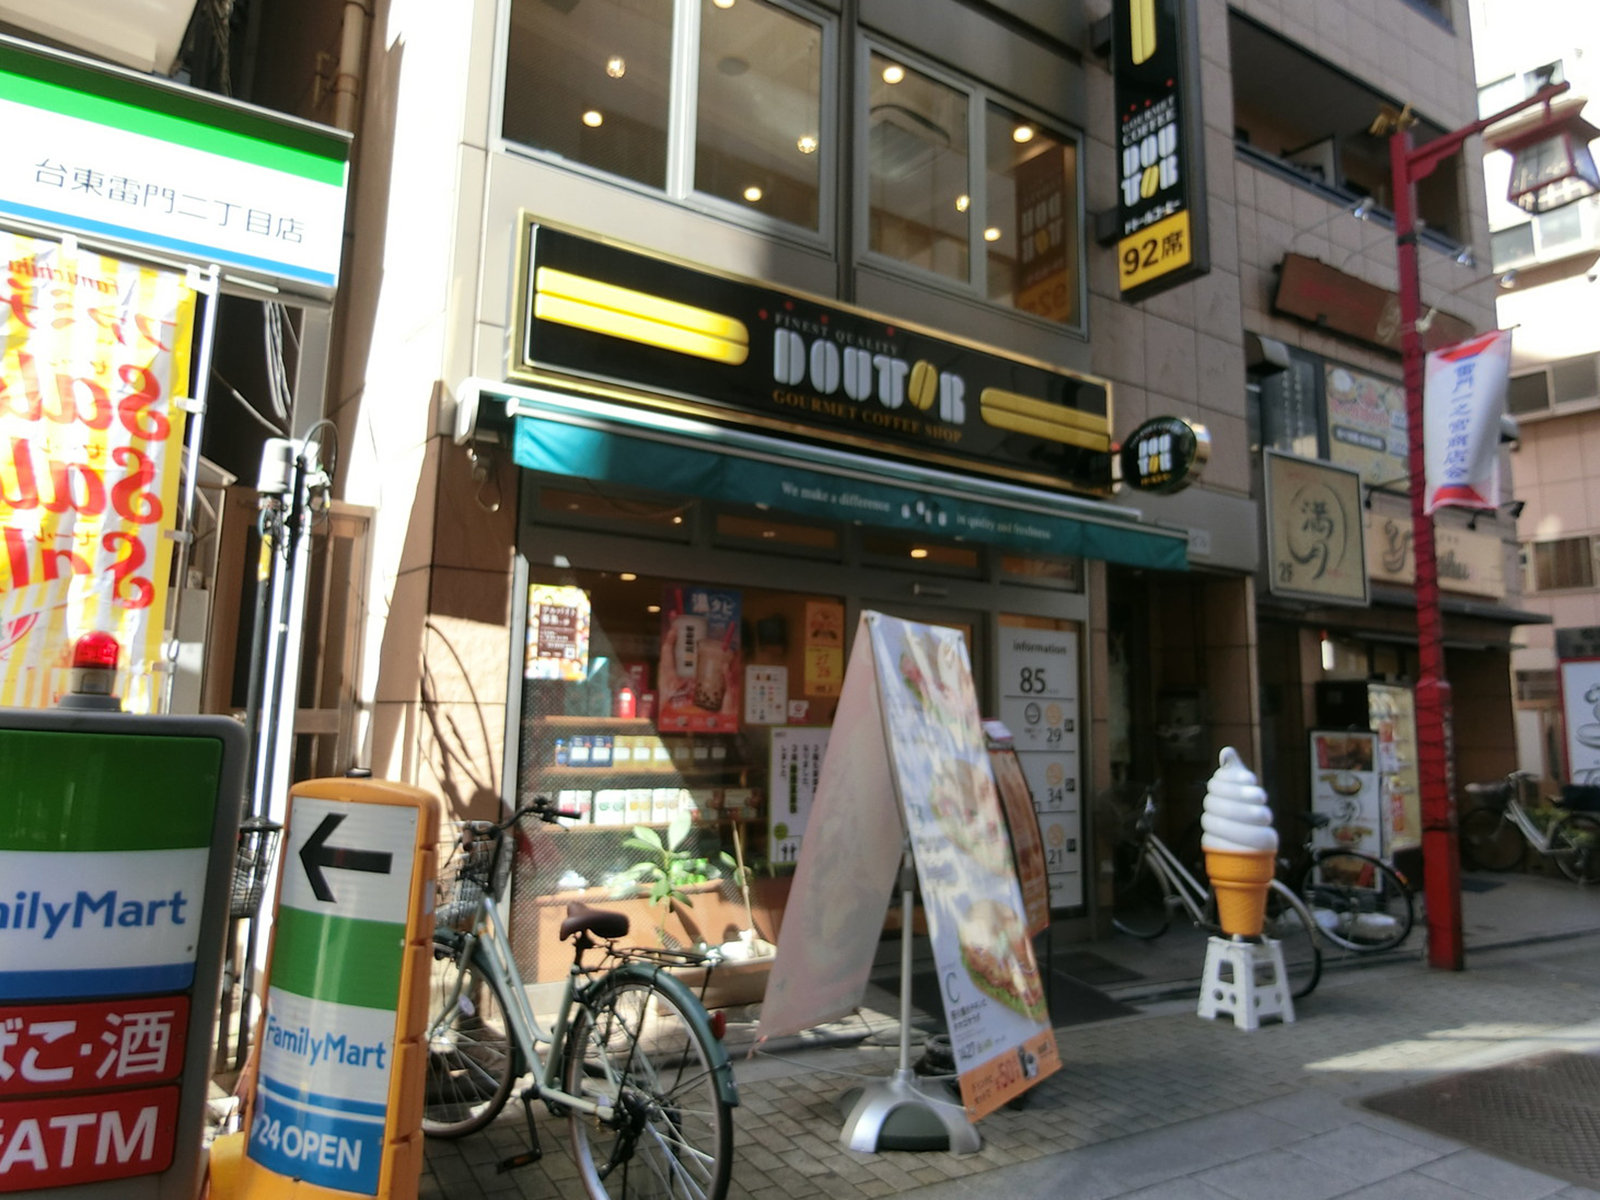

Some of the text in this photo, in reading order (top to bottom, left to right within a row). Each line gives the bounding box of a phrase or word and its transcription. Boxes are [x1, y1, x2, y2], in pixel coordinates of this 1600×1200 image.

[35, 158, 304, 243] 台東雷門二丁目店
[1123, 230, 1183, 276] 92席
[774, 312, 898, 356] FINEST QUALITY
[773, 328, 966, 424] DOUTOR
[772, 389, 963, 443] GOURMET COFFEE SHOP
[1012, 640, 1068, 655] information
[1018, 666, 1047, 695] 85
[1046, 727, 1062, 743] 29
[1047, 787, 1063, 803] 34
[1047, 849, 1063, 865] 21
[266, 1015, 387, 1070] FamilyMart
[0, 1105, 159, 1174] ATM
